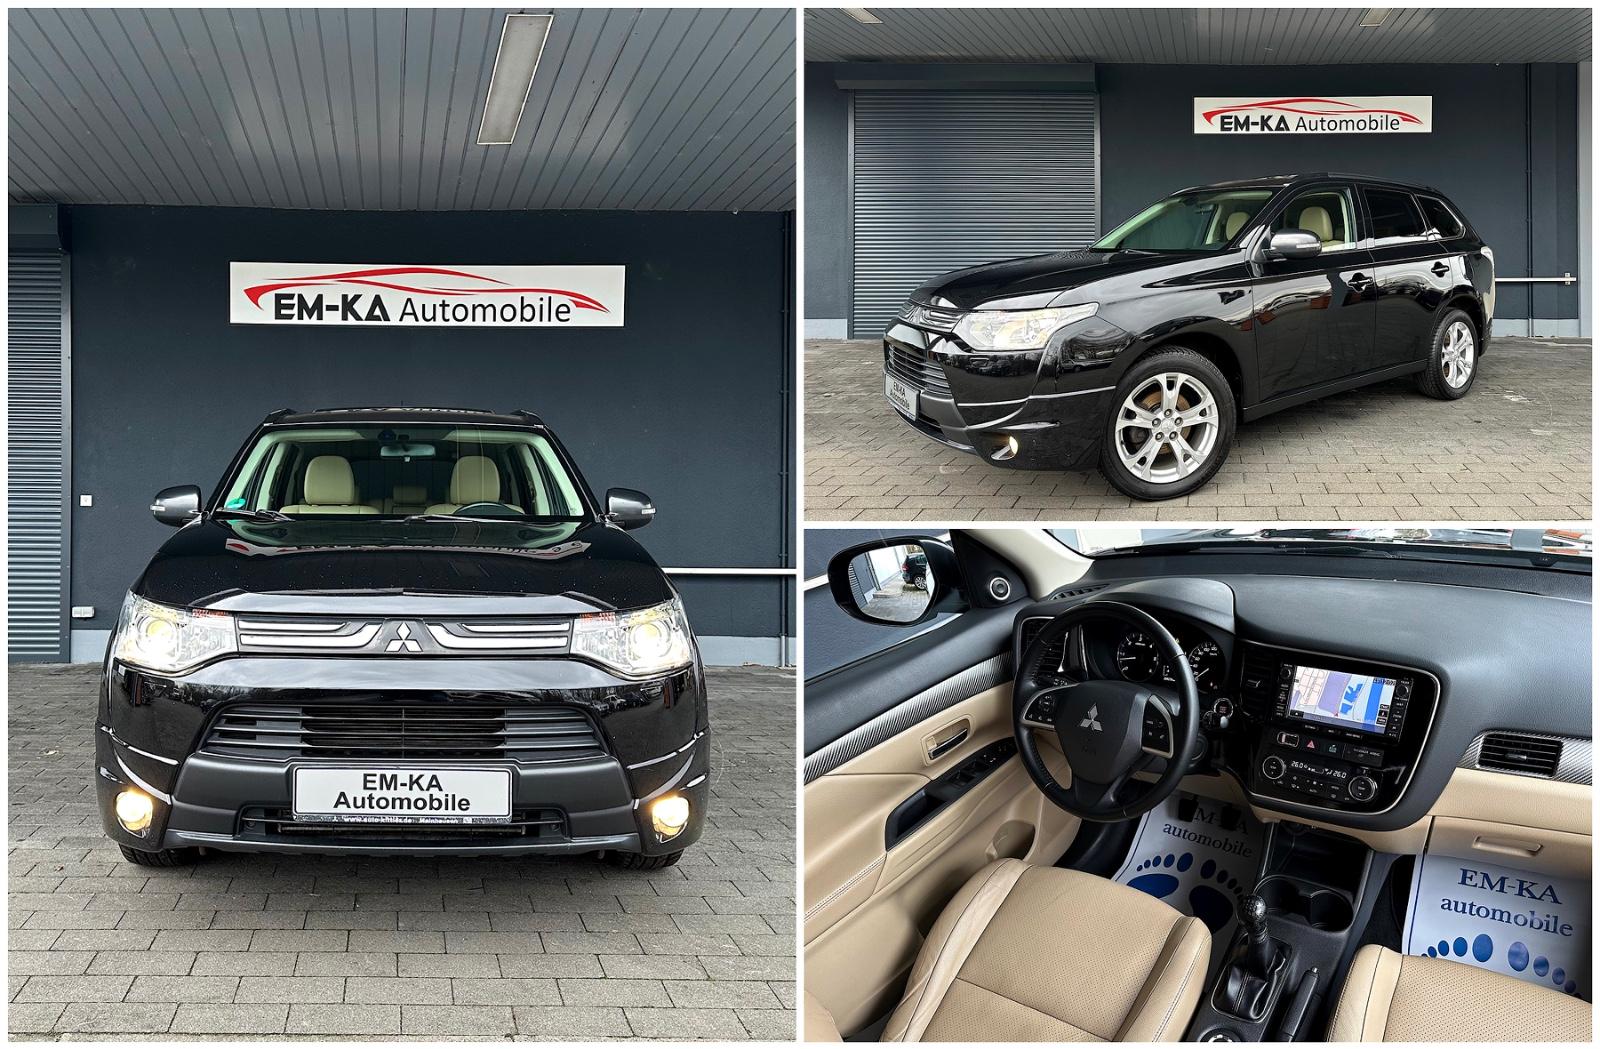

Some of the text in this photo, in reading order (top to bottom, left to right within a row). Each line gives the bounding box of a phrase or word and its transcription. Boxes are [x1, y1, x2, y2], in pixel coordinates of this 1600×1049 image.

[1220, 115, 1400, 132] EM-KA Automobile
[273, 293, 572, 323] EM-KA Automobile
[362, 773, 443, 792] EM-KA
[333, 791, 471, 812] Automobile
[1163, 822, 1253, 858] automobile
[1458, 868, 1563, 905] EM-KA
[1440, 898, 1574, 937] automobile
